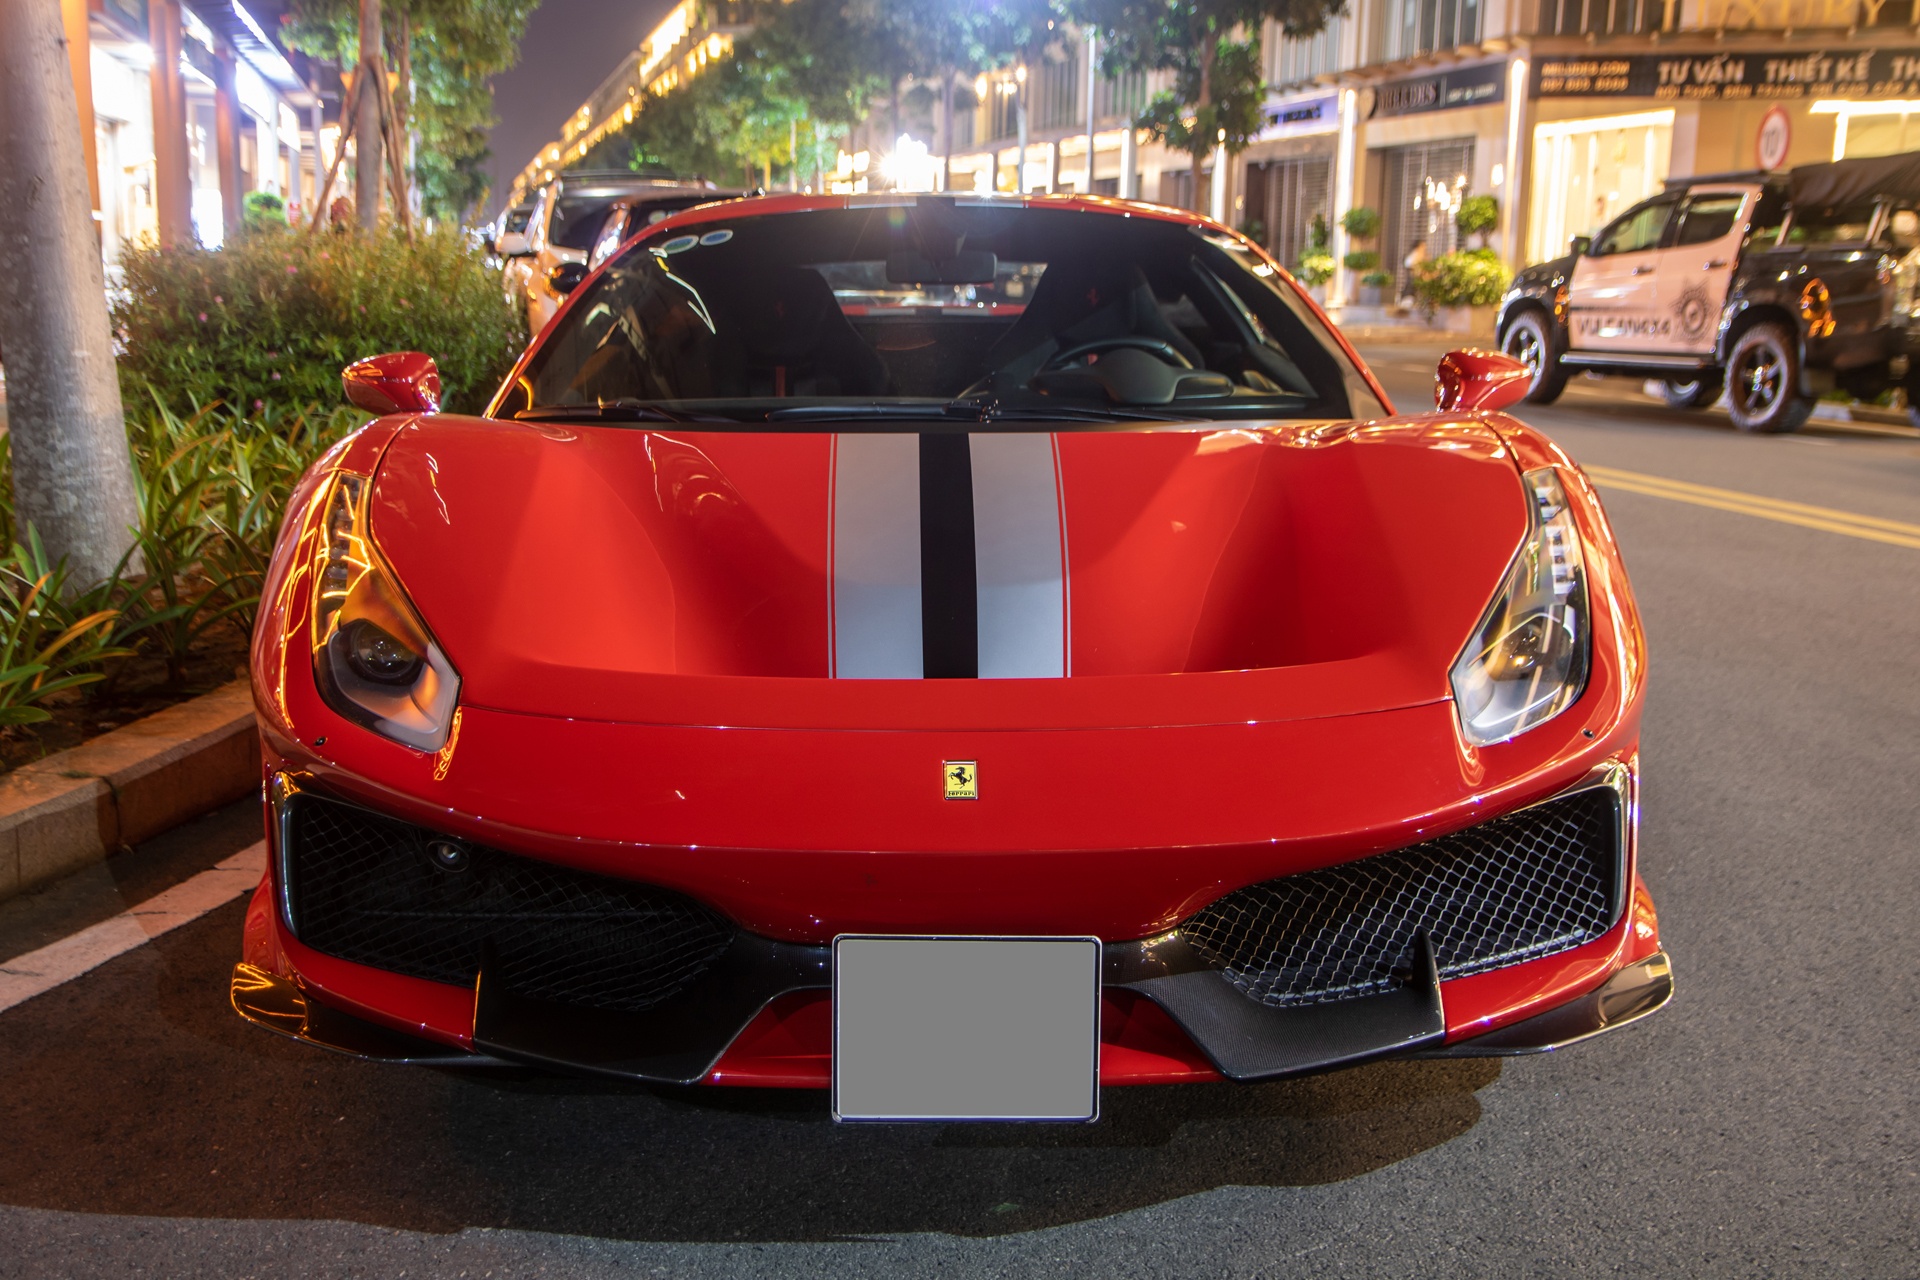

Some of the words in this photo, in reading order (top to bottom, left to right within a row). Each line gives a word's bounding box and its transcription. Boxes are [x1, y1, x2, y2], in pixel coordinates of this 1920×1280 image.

[1657, 58, 1692, 84] TƯ
[1693, 50, 1745, 83] VẤN
[1763, 49, 1833, 83] THIẾT
[1834, 48, 1877, 81] KẾ
